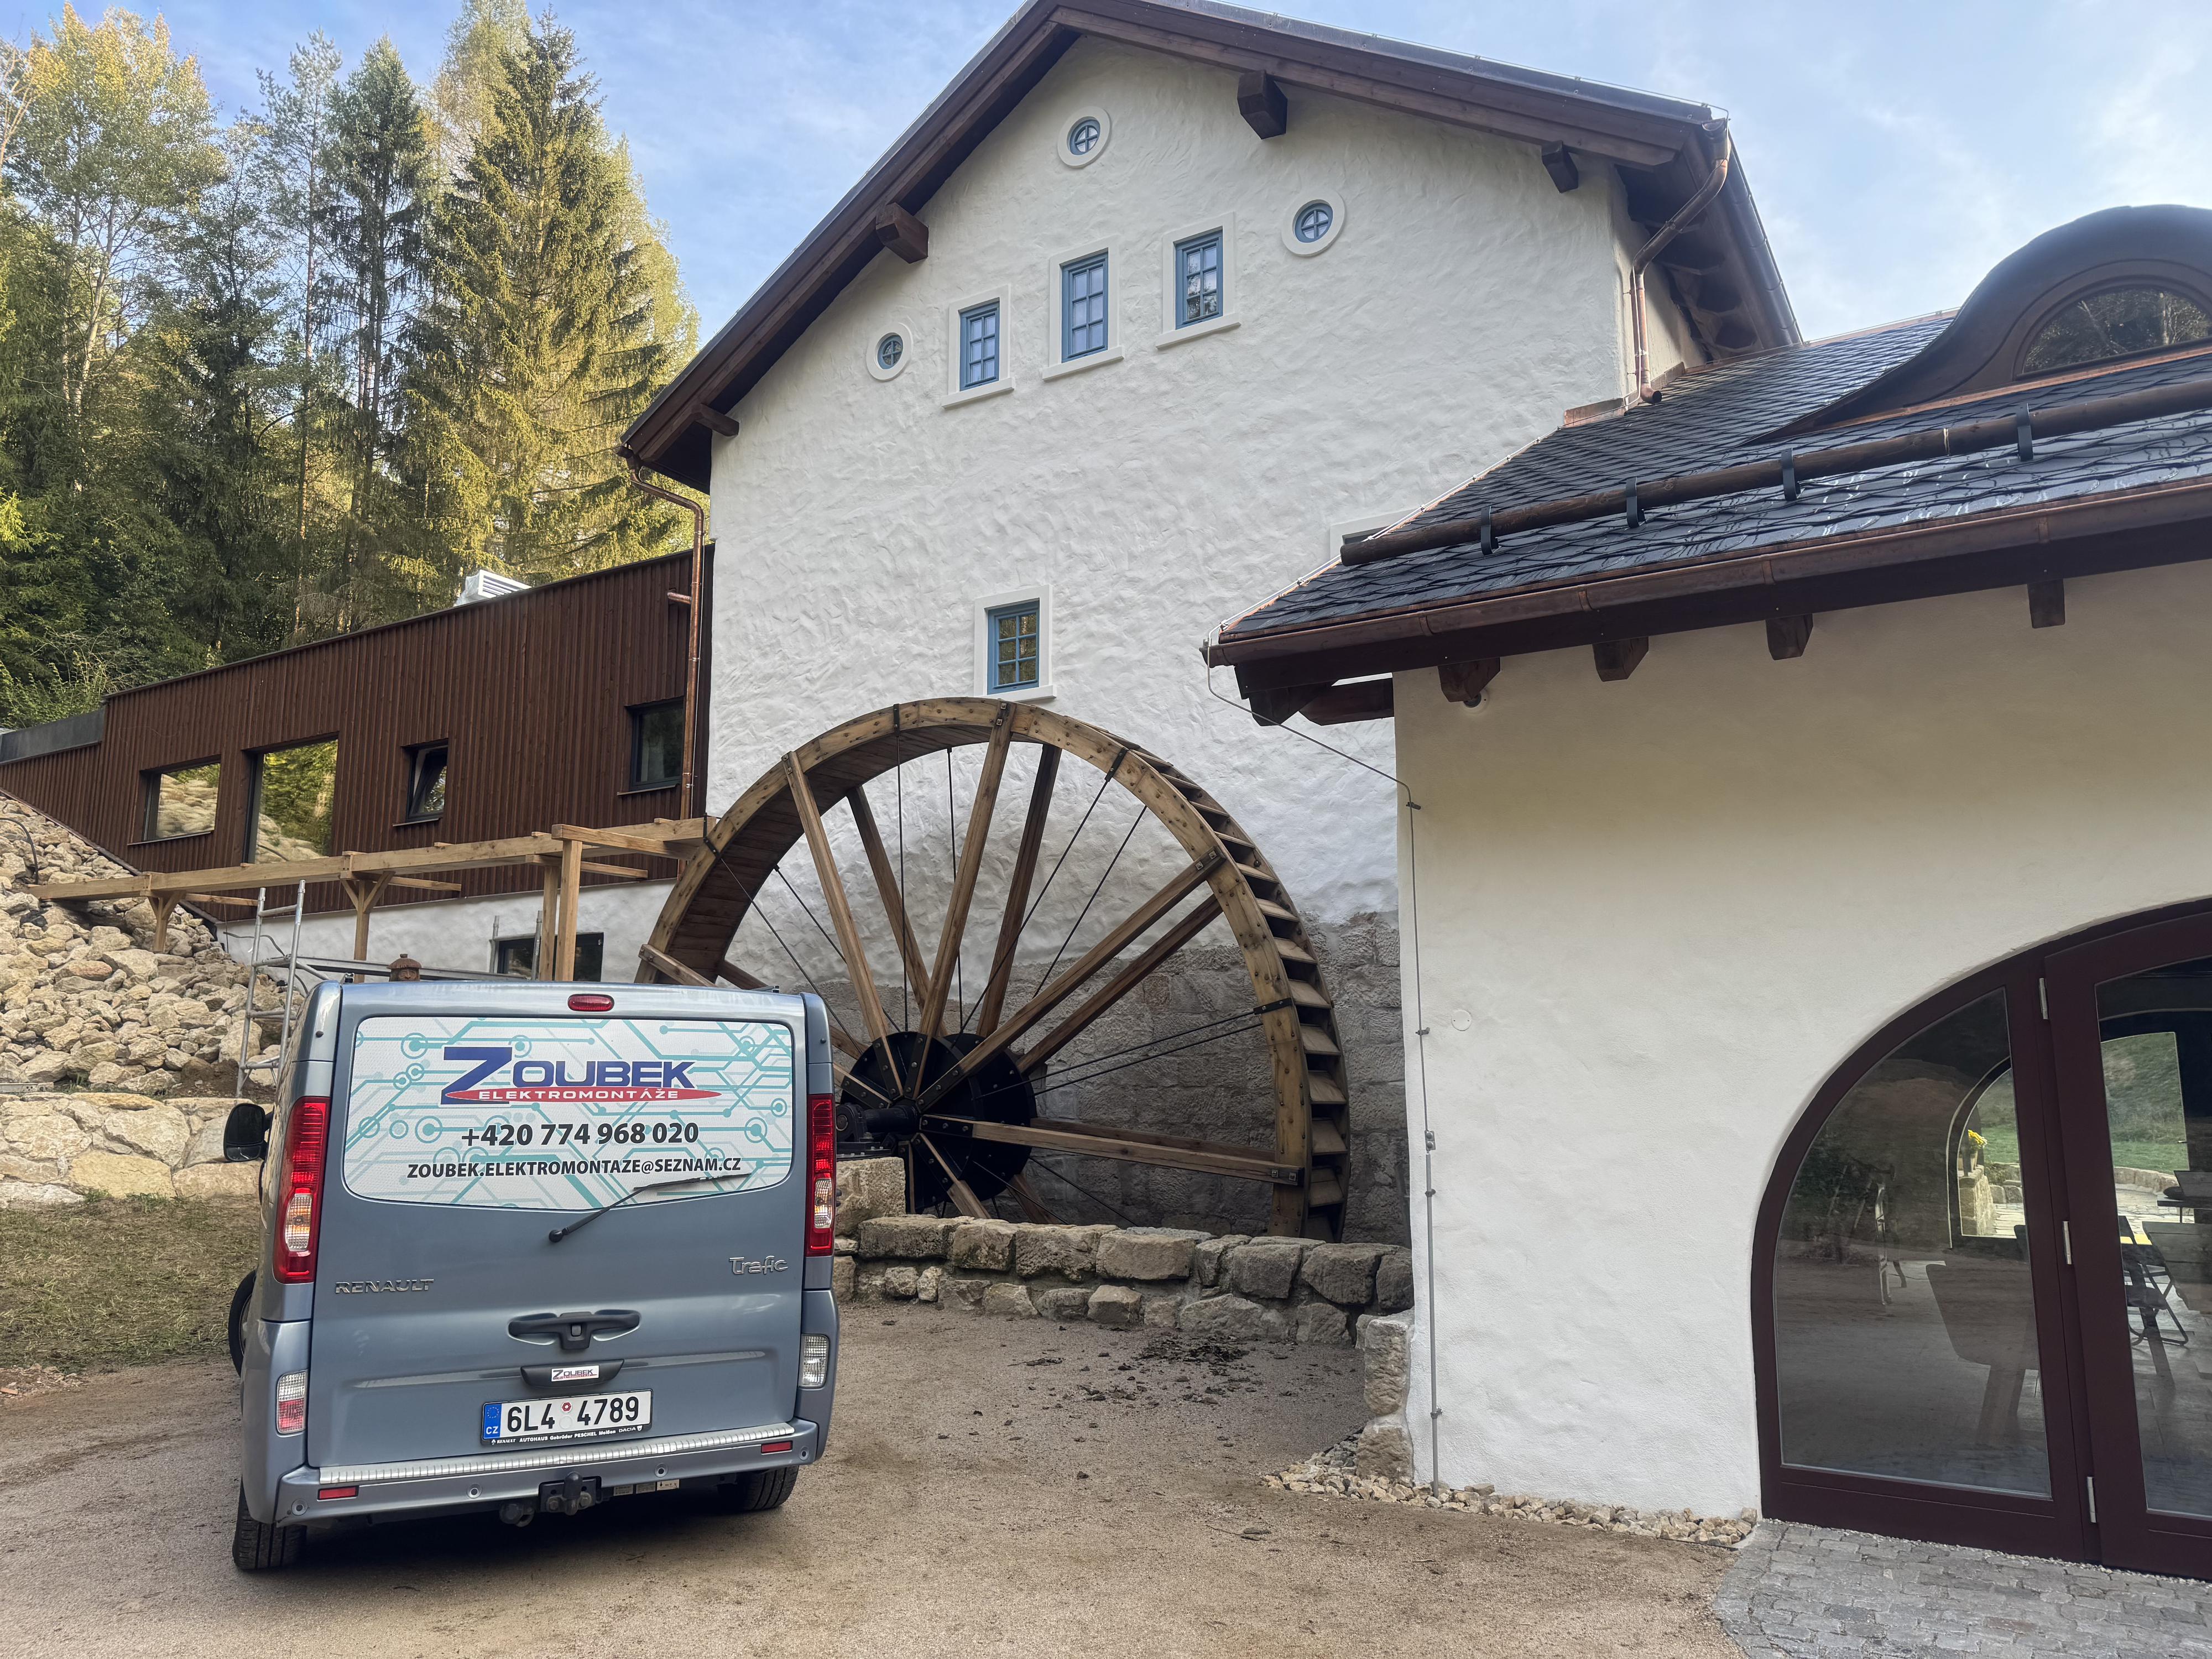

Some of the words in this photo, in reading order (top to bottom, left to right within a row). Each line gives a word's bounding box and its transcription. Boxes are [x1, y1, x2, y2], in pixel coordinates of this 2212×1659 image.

[441, 1047, 696, 1104] ZOUBEK
[479, 1088, 679, 1100] ELEKTROMONTÁŽE
[461, 1124, 533, 1146] +420
[541, 1124, 590, 1145] 774
[597, 1122, 646, 1145] 968
[652, 1122, 699, 1144] 020
[407, 1157, 741, 1178] ZOUBEK.ELEKTROMONTAZE@SEZNAM.CZ
[729, 1255, 789, 1275] Trafic
[335, 1279, 434, 1294] RENAULT
[553, 1369, 593, 1380] ZOUBEK
[507, 1403, 555, 1432] 6L4
[577, 1396, 639, 1426] 4789
[486, 1426, 499, 1434] CZ
